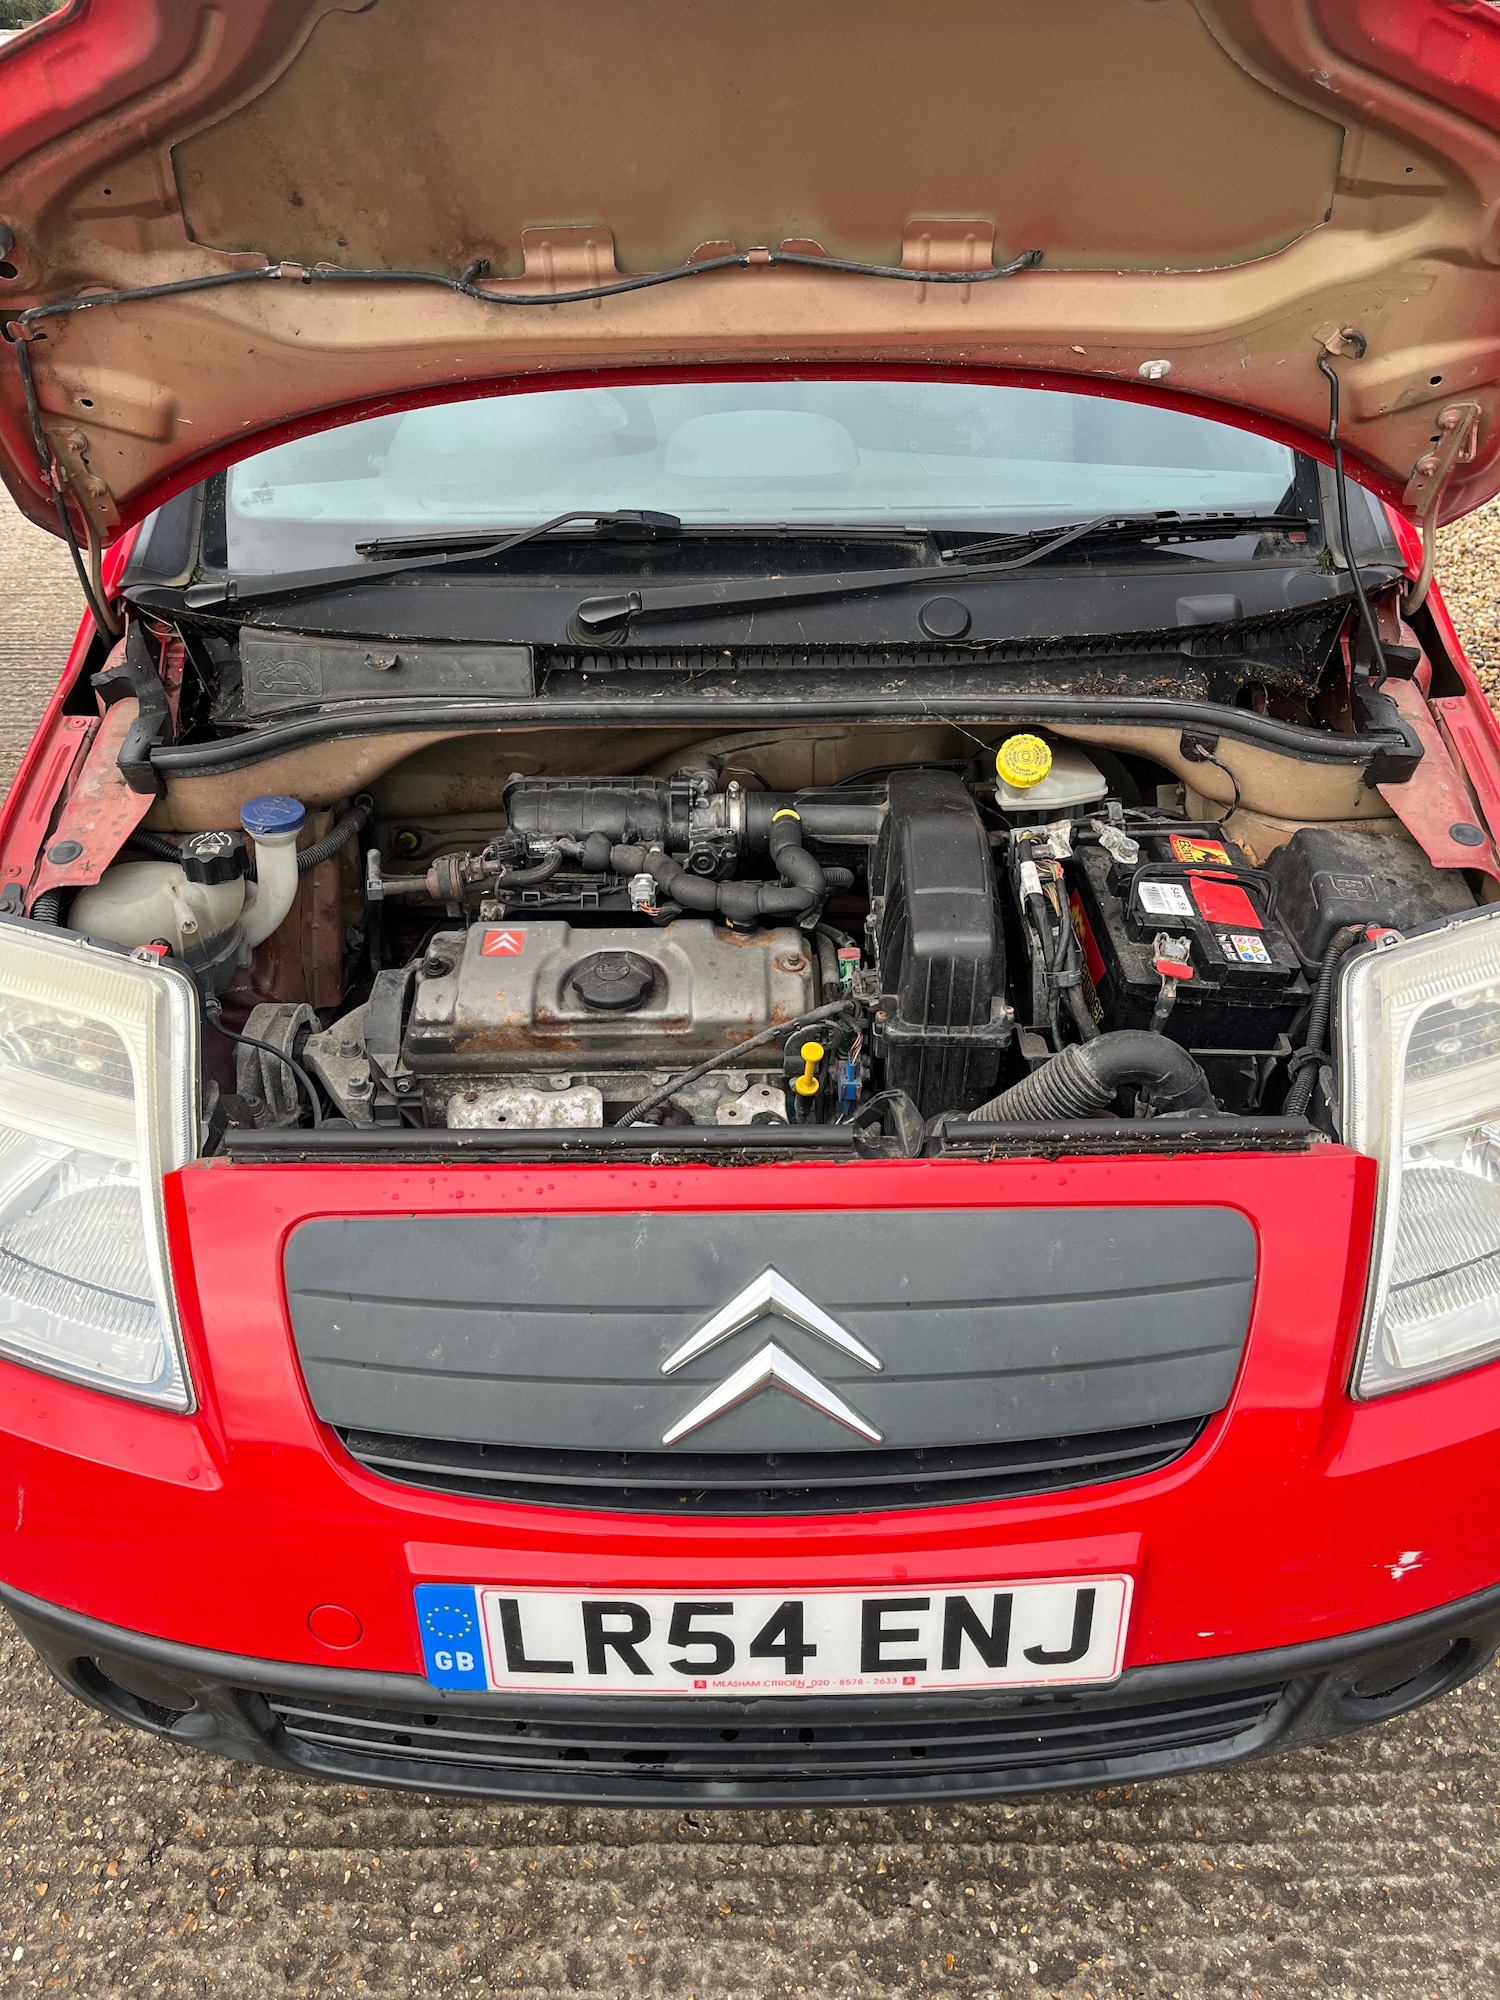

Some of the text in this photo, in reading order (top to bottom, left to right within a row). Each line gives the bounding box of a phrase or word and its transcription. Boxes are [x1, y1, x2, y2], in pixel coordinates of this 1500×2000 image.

[1178, 839, 1196, 863] Bann
[1081, 951, 1105, 1024] anner
[498, 1588, 1096, 1676] LR54 ENJ
[434, 1651, 475, 1671] GB
[839, 1678, 863, 1686] 8578
[873, 1677, 898, 1685] 2633
